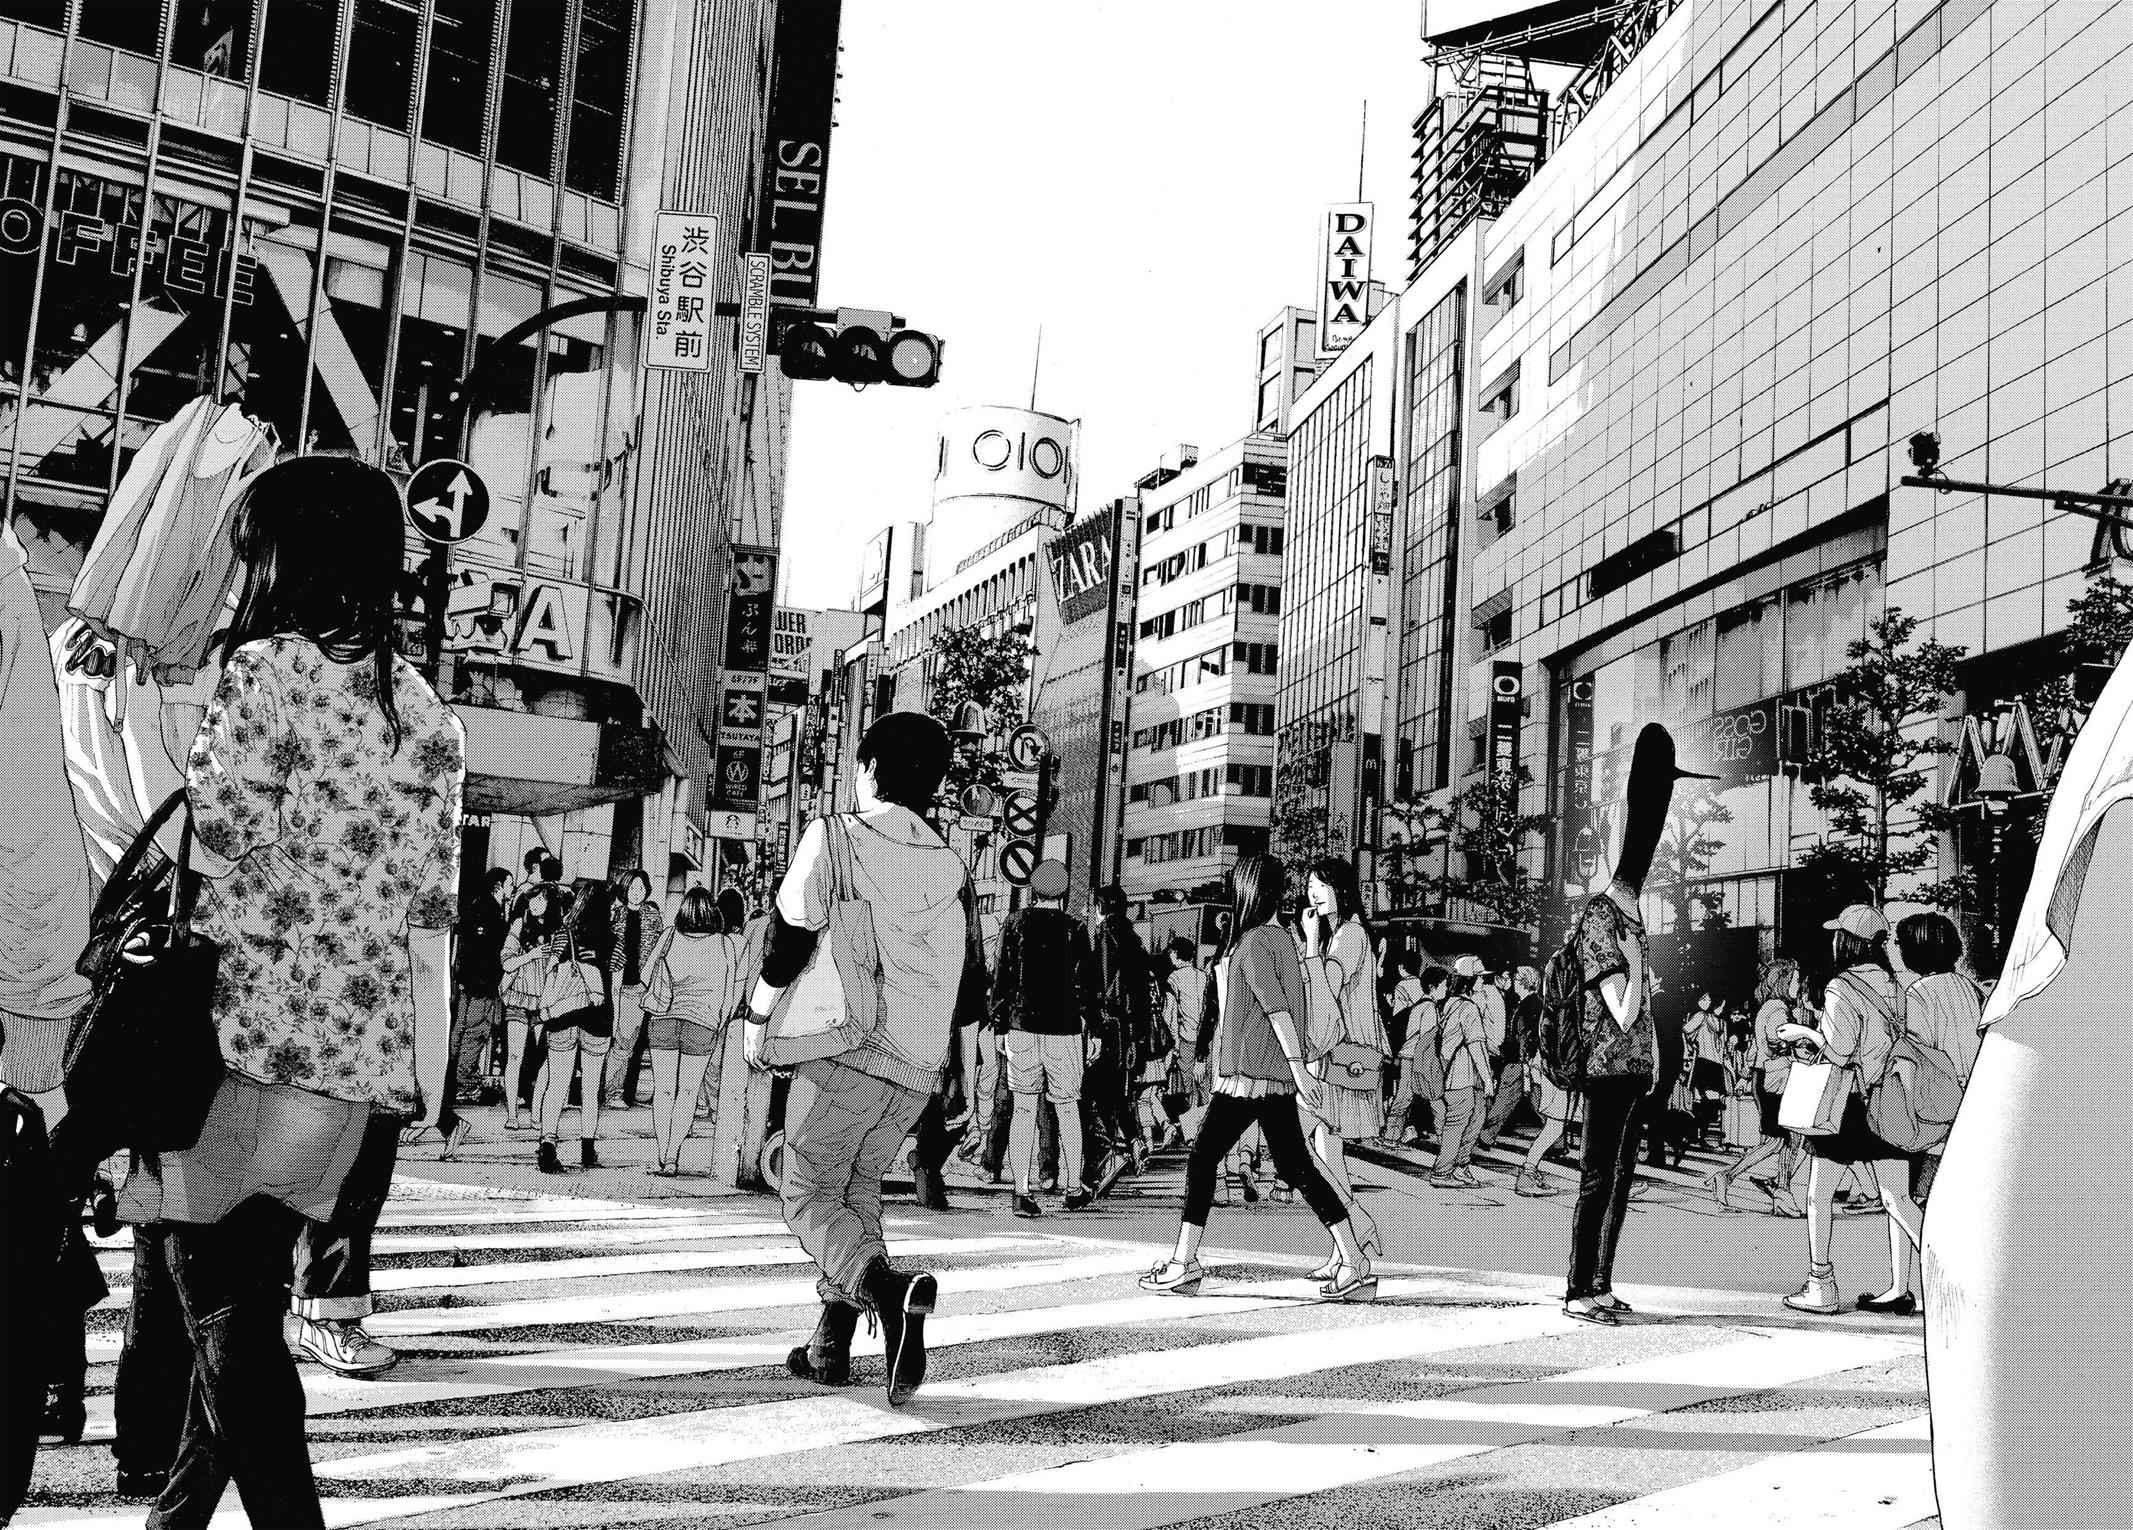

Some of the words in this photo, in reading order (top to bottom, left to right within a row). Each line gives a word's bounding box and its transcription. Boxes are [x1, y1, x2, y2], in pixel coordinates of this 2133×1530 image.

[0, 197, 259, 305] OFFEE
[656, 244, 677, 304] Shibuya
[1328, 213, 1367, 324] DAIWA
[675, 226, 710, 358] 渋谷駅前
[749, 260, 766, 320] SCRAMBLE
[656, 310, 672, 340] Sta.
[744, 323, 762, 367] SYSTEM
[728, 694, 757, 723] 本
